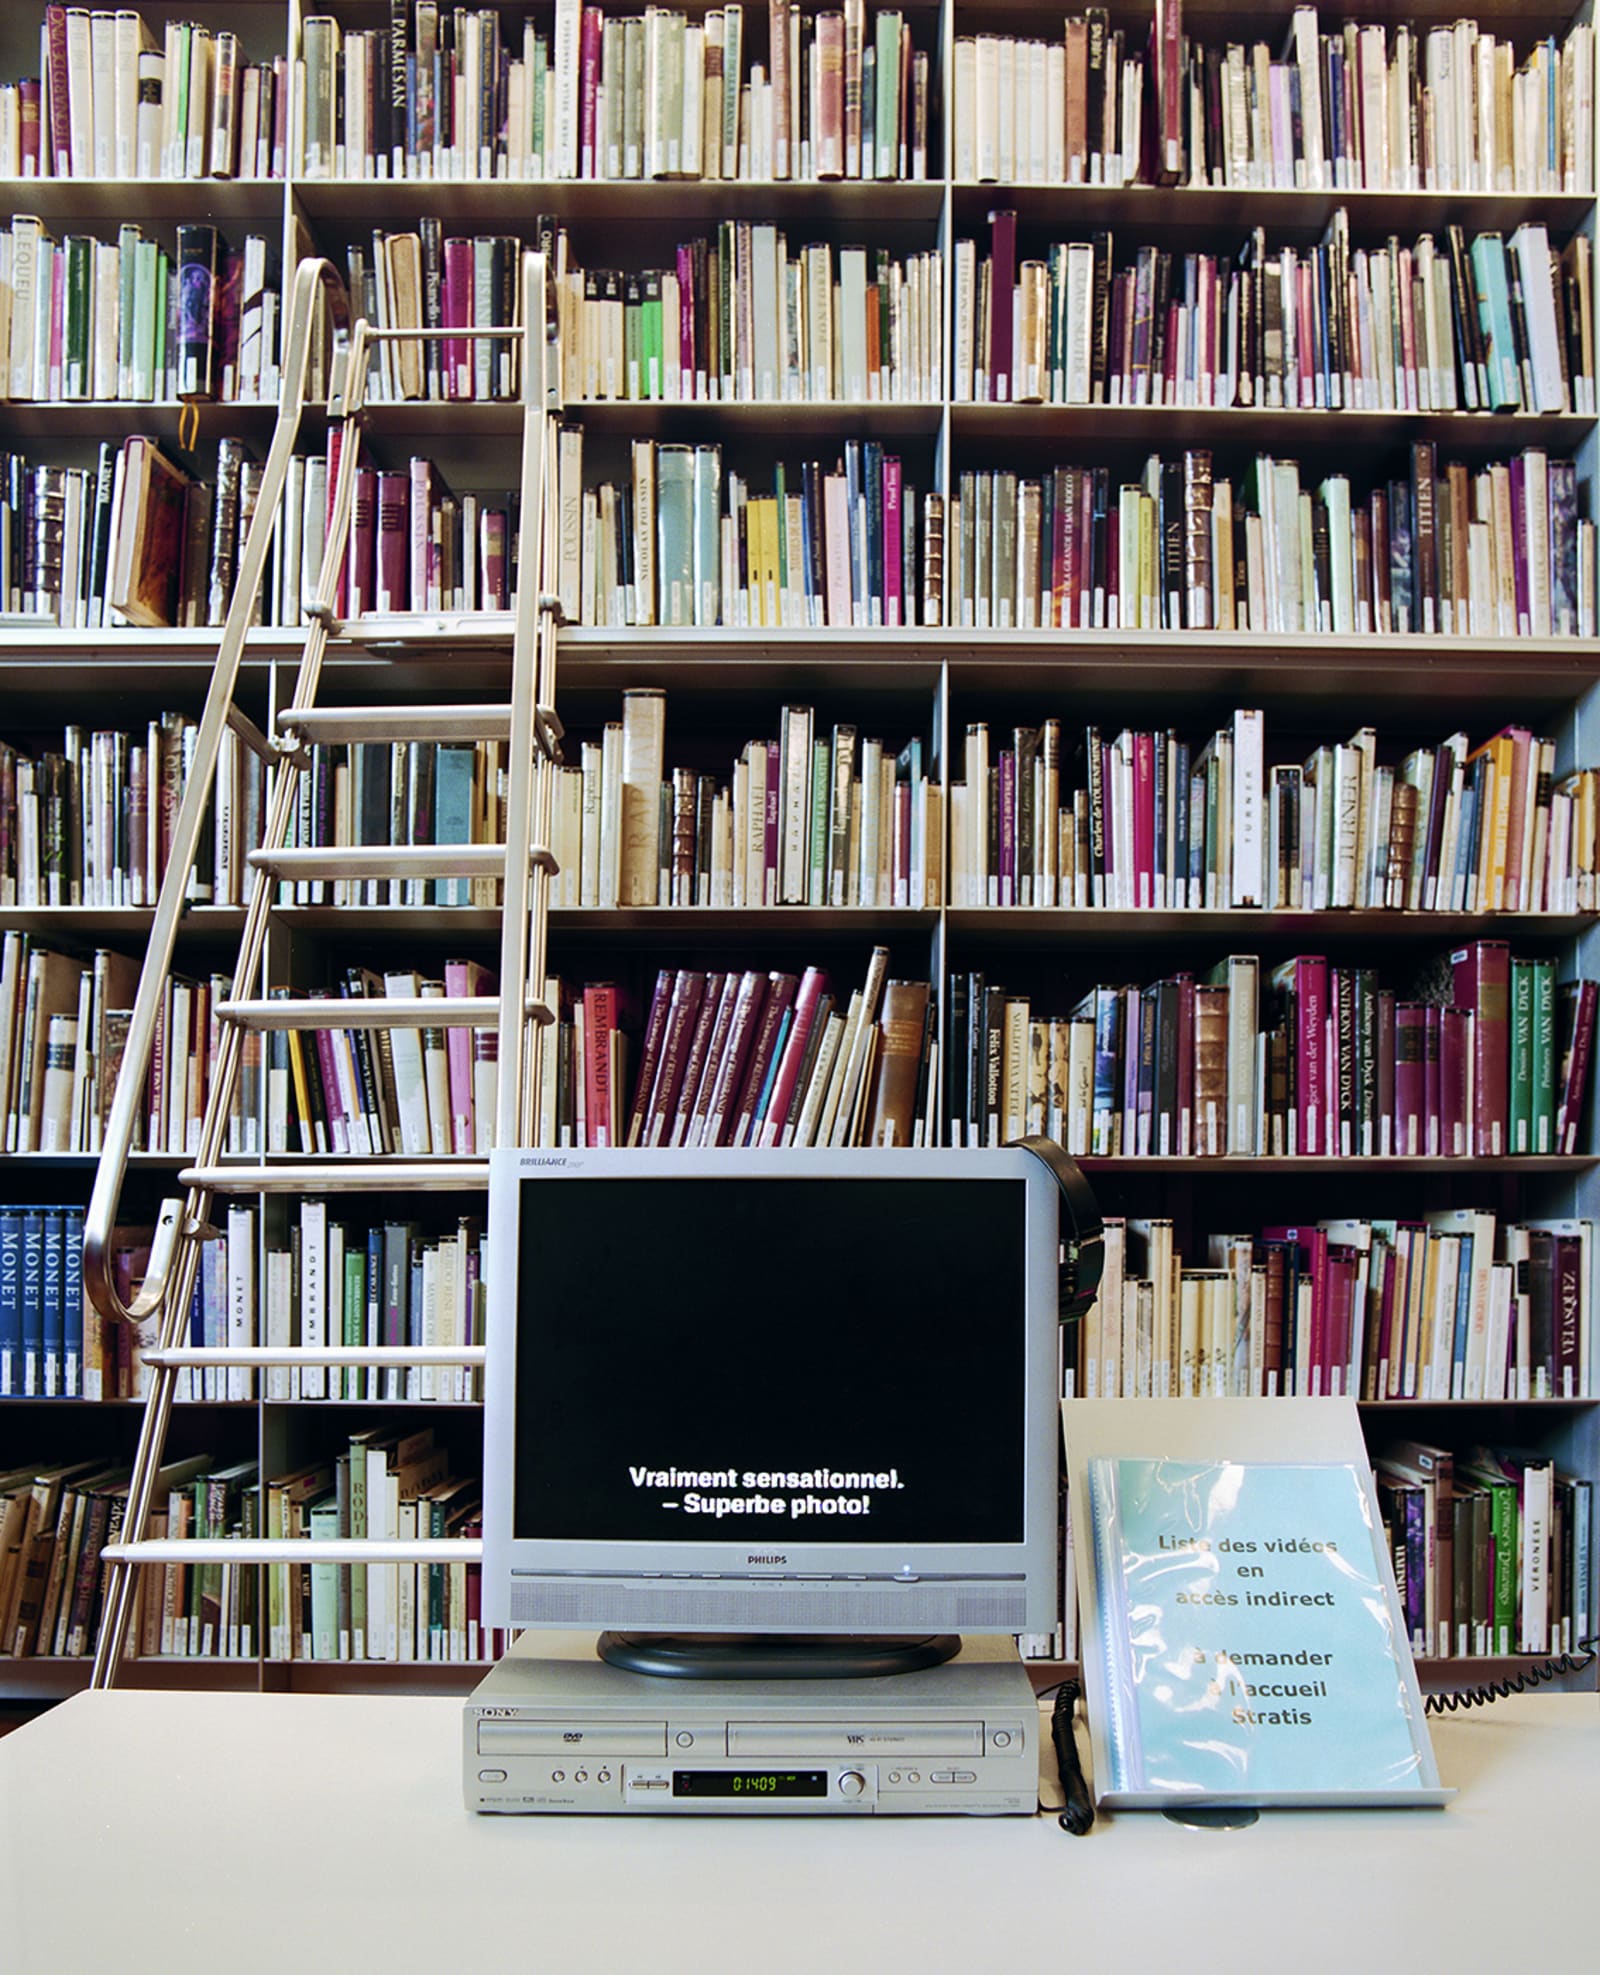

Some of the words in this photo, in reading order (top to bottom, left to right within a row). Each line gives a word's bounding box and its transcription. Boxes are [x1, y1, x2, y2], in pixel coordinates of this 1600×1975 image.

[50, 6, 65, 48] VINCI
[53, 49, 66, 68] DE
[391, 19, 407, 109] PARMESAN
[54, 72, 68, 144] LEONARD
[16, 231, 33, 302] LEQUEU
[1074, 267, 1087, 314] CLAUS
[1073, 320, 1087, 374] SLUTER
[415, 479, 425, 551] POUSSIN
[640, 477, 649, 526] POUSSIN
[1417, 477, 1432, 537] TITIEN
[563, 495, 577, 562] POUSSIN
[1167, 521, 1180, 574] TITIEN
[640, 529, 649, 582] NICOLAS
[628, 709, 654, 850] RAPHAEL
[1091, 735, 1102, 805] TOURNEMINE
[752, 781, 764, 853] RAPHAEL
[1244, 771, 1252, 843] TURNER
[1339, 775, 1357, 864] TURNER
[1093, 820, 1104, 857] Charles
[1305, 995, 1320, 1039] Weyden
[1340, 976, 1351, 1041] ANTHONY
[1360, 992, 1374, 1036] Anthony
[1517, 976, 1529, 1011] DYCK
[1541, 976, 1551, 1011] DYCK
[593, 993, 609, 1095] REMBRANDT
[1306, 1041, 1317, 1060] der
[1364, 1039, 1372, 1057] van
[1517, 1015, 1529, 1044] VAN
[1541, 1015, 1551, 1044] VAN
[1309, 1061, 1317, 1082] van
[1340, 1044, 1351, 1071] VAN
[1361, 1059, 1374, 1086] Dyck
[636, 1061, 652, 1113] REMBRAND
[659, 1062, 676, 1114] REMBRAND
[681, 1062, 700, 1114] REMBRAND
[702, 1062, 720, 1113] REMBRAND
[719, 1062, 737, 1113] REMBRAND
[745, 1062, 765, 1113] REMBRAND
[1340, 1074, 1352, 1111] DYCK
[519, 1158, 567, 1166] BRILLIANCE
[2, 1231, 19, 1310] MONET
[25, 1231, 41, 1310] MONET
[45, 1232, 61, 1311] MONET
[66, 1233, 81, 1311] MONET
[308, 1244, 316, 1341] EMBRANDT
[1561, 1271, 1578, 1356] VELASQUEZ
[215, 1483, 226, 1520] EDVARD
[628, 1466, 738, 1488] Vraiment
[741, 1468, 905, 1489] sensationnel.
[353, 1482, 364, 1536] RODI
[683, 1492, 786, 1519] Superbe
[791, 1495, 871, 1519] photo!
[747, 1555, 787, 1565] PHILIPS
[1218, 1538, 1258, 1553] des
[1264, 1537, 1338, 1553] vidéos
[1532, 1521, 1540, 1592] VERONESE
[1237, 1564, 1265, 1578] en
[1175, 1589, 1239, 1606] accès
[1246, 1591, 1336, 1607] indirect
[1215, 1650, 1334, 1666] demander
[472, 1708, 519, 1717] SONY
[1231, 1708, 1313, 1725] Stratis
[846, 1734, 865, 1744] VHS
